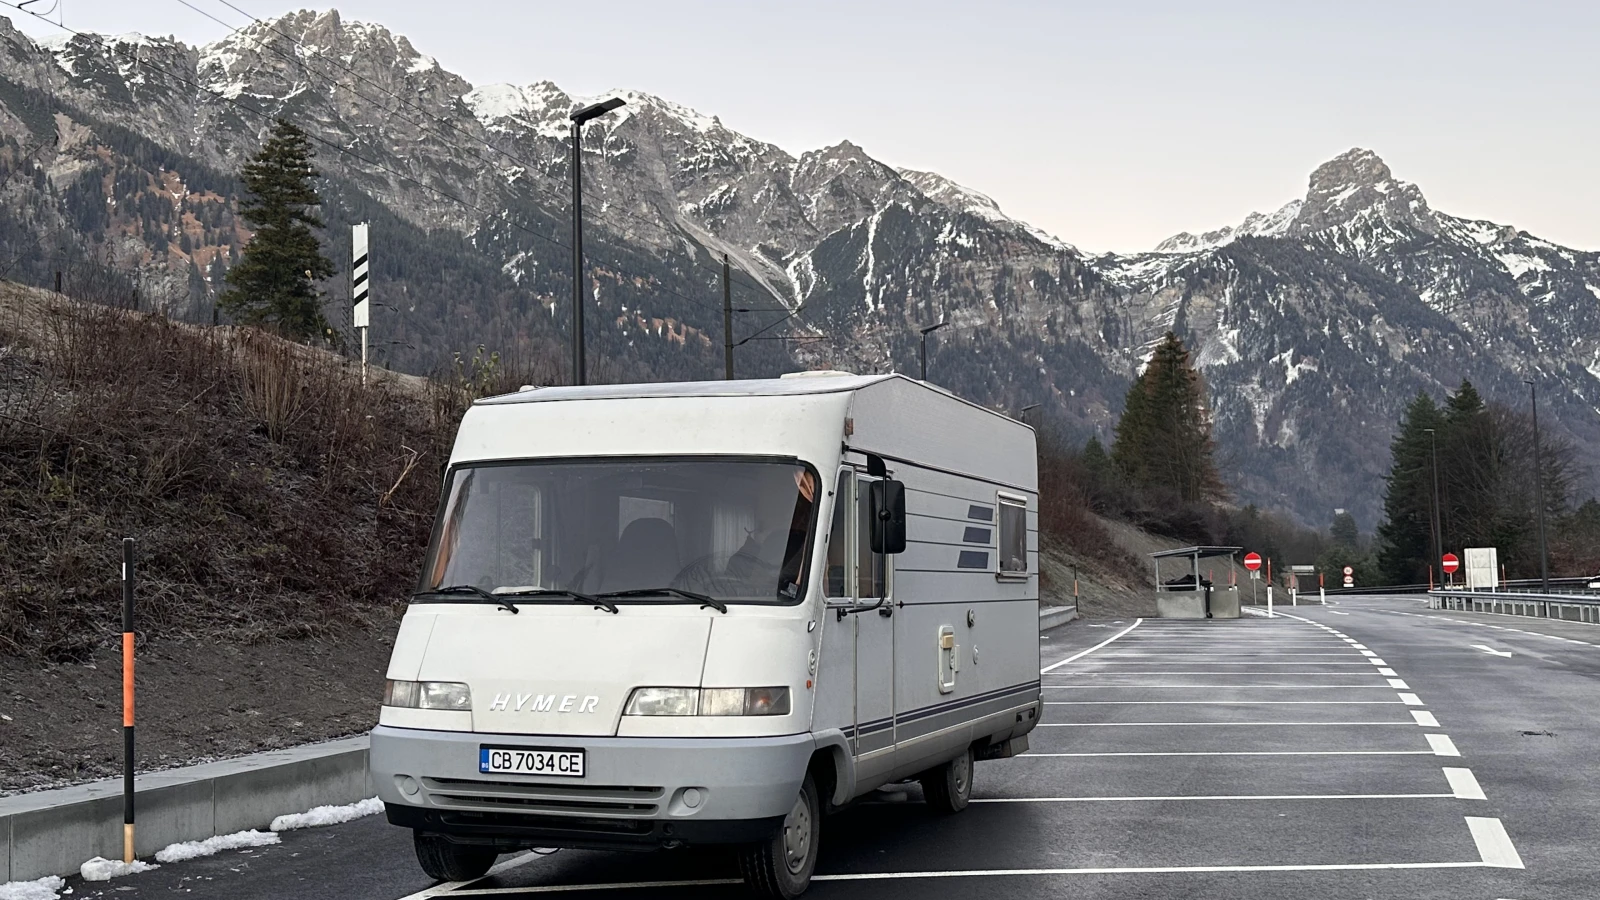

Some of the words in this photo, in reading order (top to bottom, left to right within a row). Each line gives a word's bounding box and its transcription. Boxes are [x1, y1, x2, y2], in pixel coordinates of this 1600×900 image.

[490, 693, 599, 713] HYMER
[492, 752, 512, 769] CB
[516, 753, 555, 771] 7034
[559, 755, 580, 772] CE
